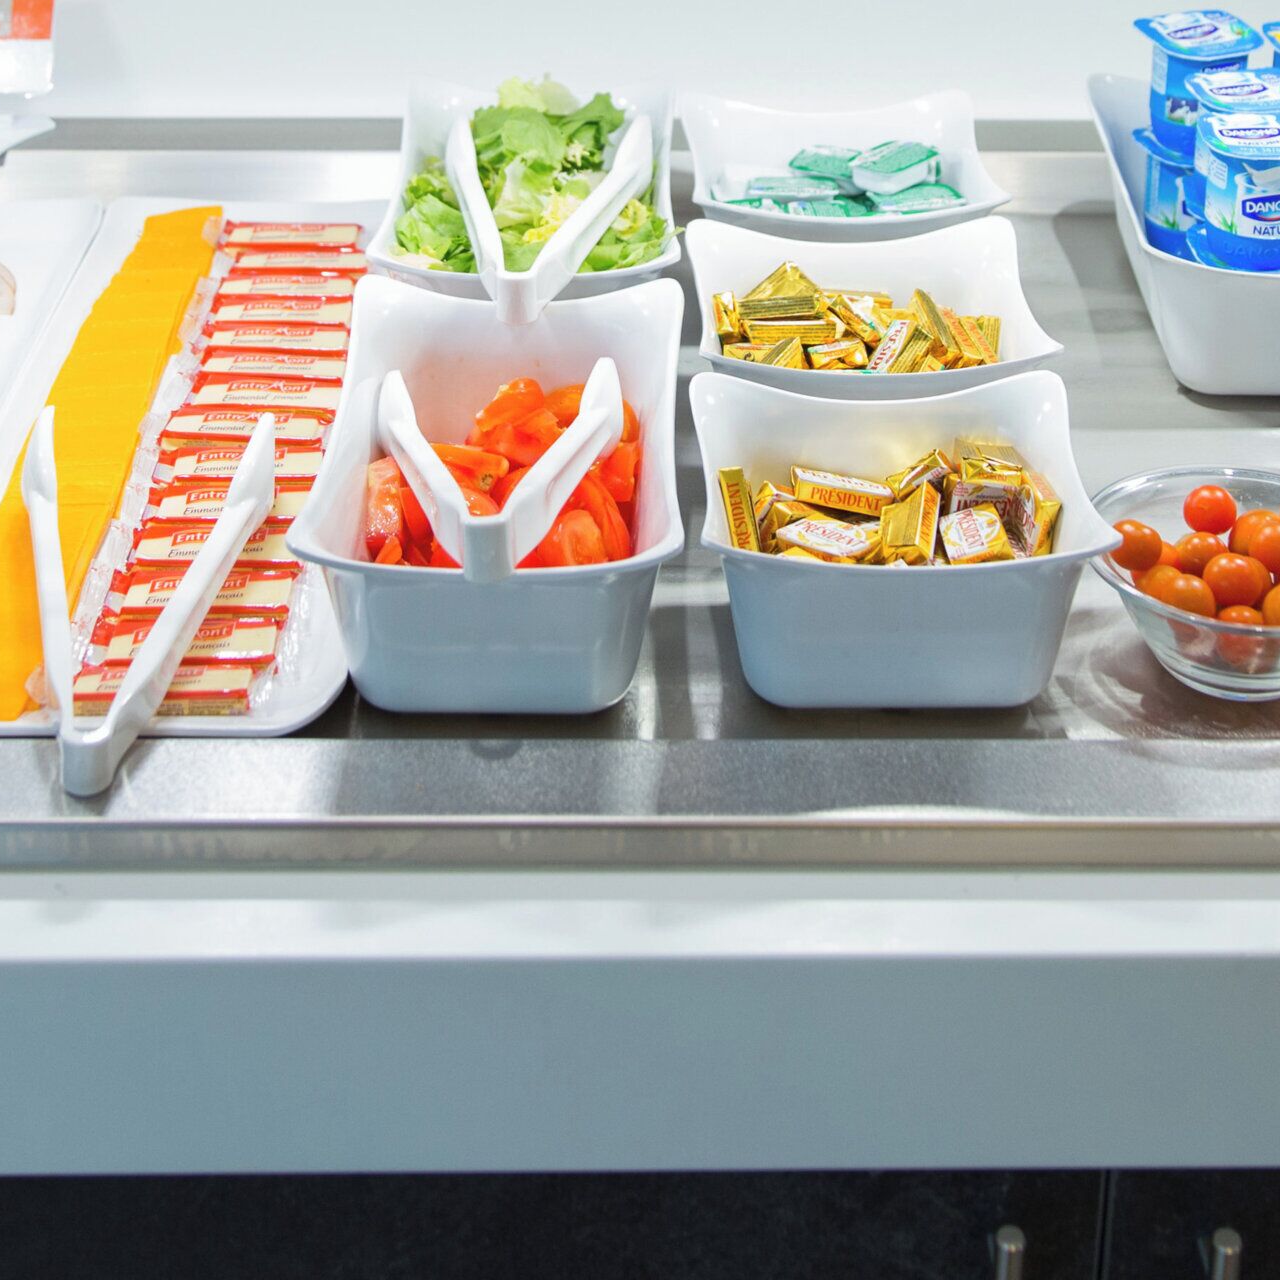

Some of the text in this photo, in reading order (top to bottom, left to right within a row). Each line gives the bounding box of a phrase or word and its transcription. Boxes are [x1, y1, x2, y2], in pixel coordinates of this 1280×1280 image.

[193, 465, 239, 474] Emmenta
[810, 486, 883, 511] PRÉSIDENT
[183, 506, 225, 516] Emment
